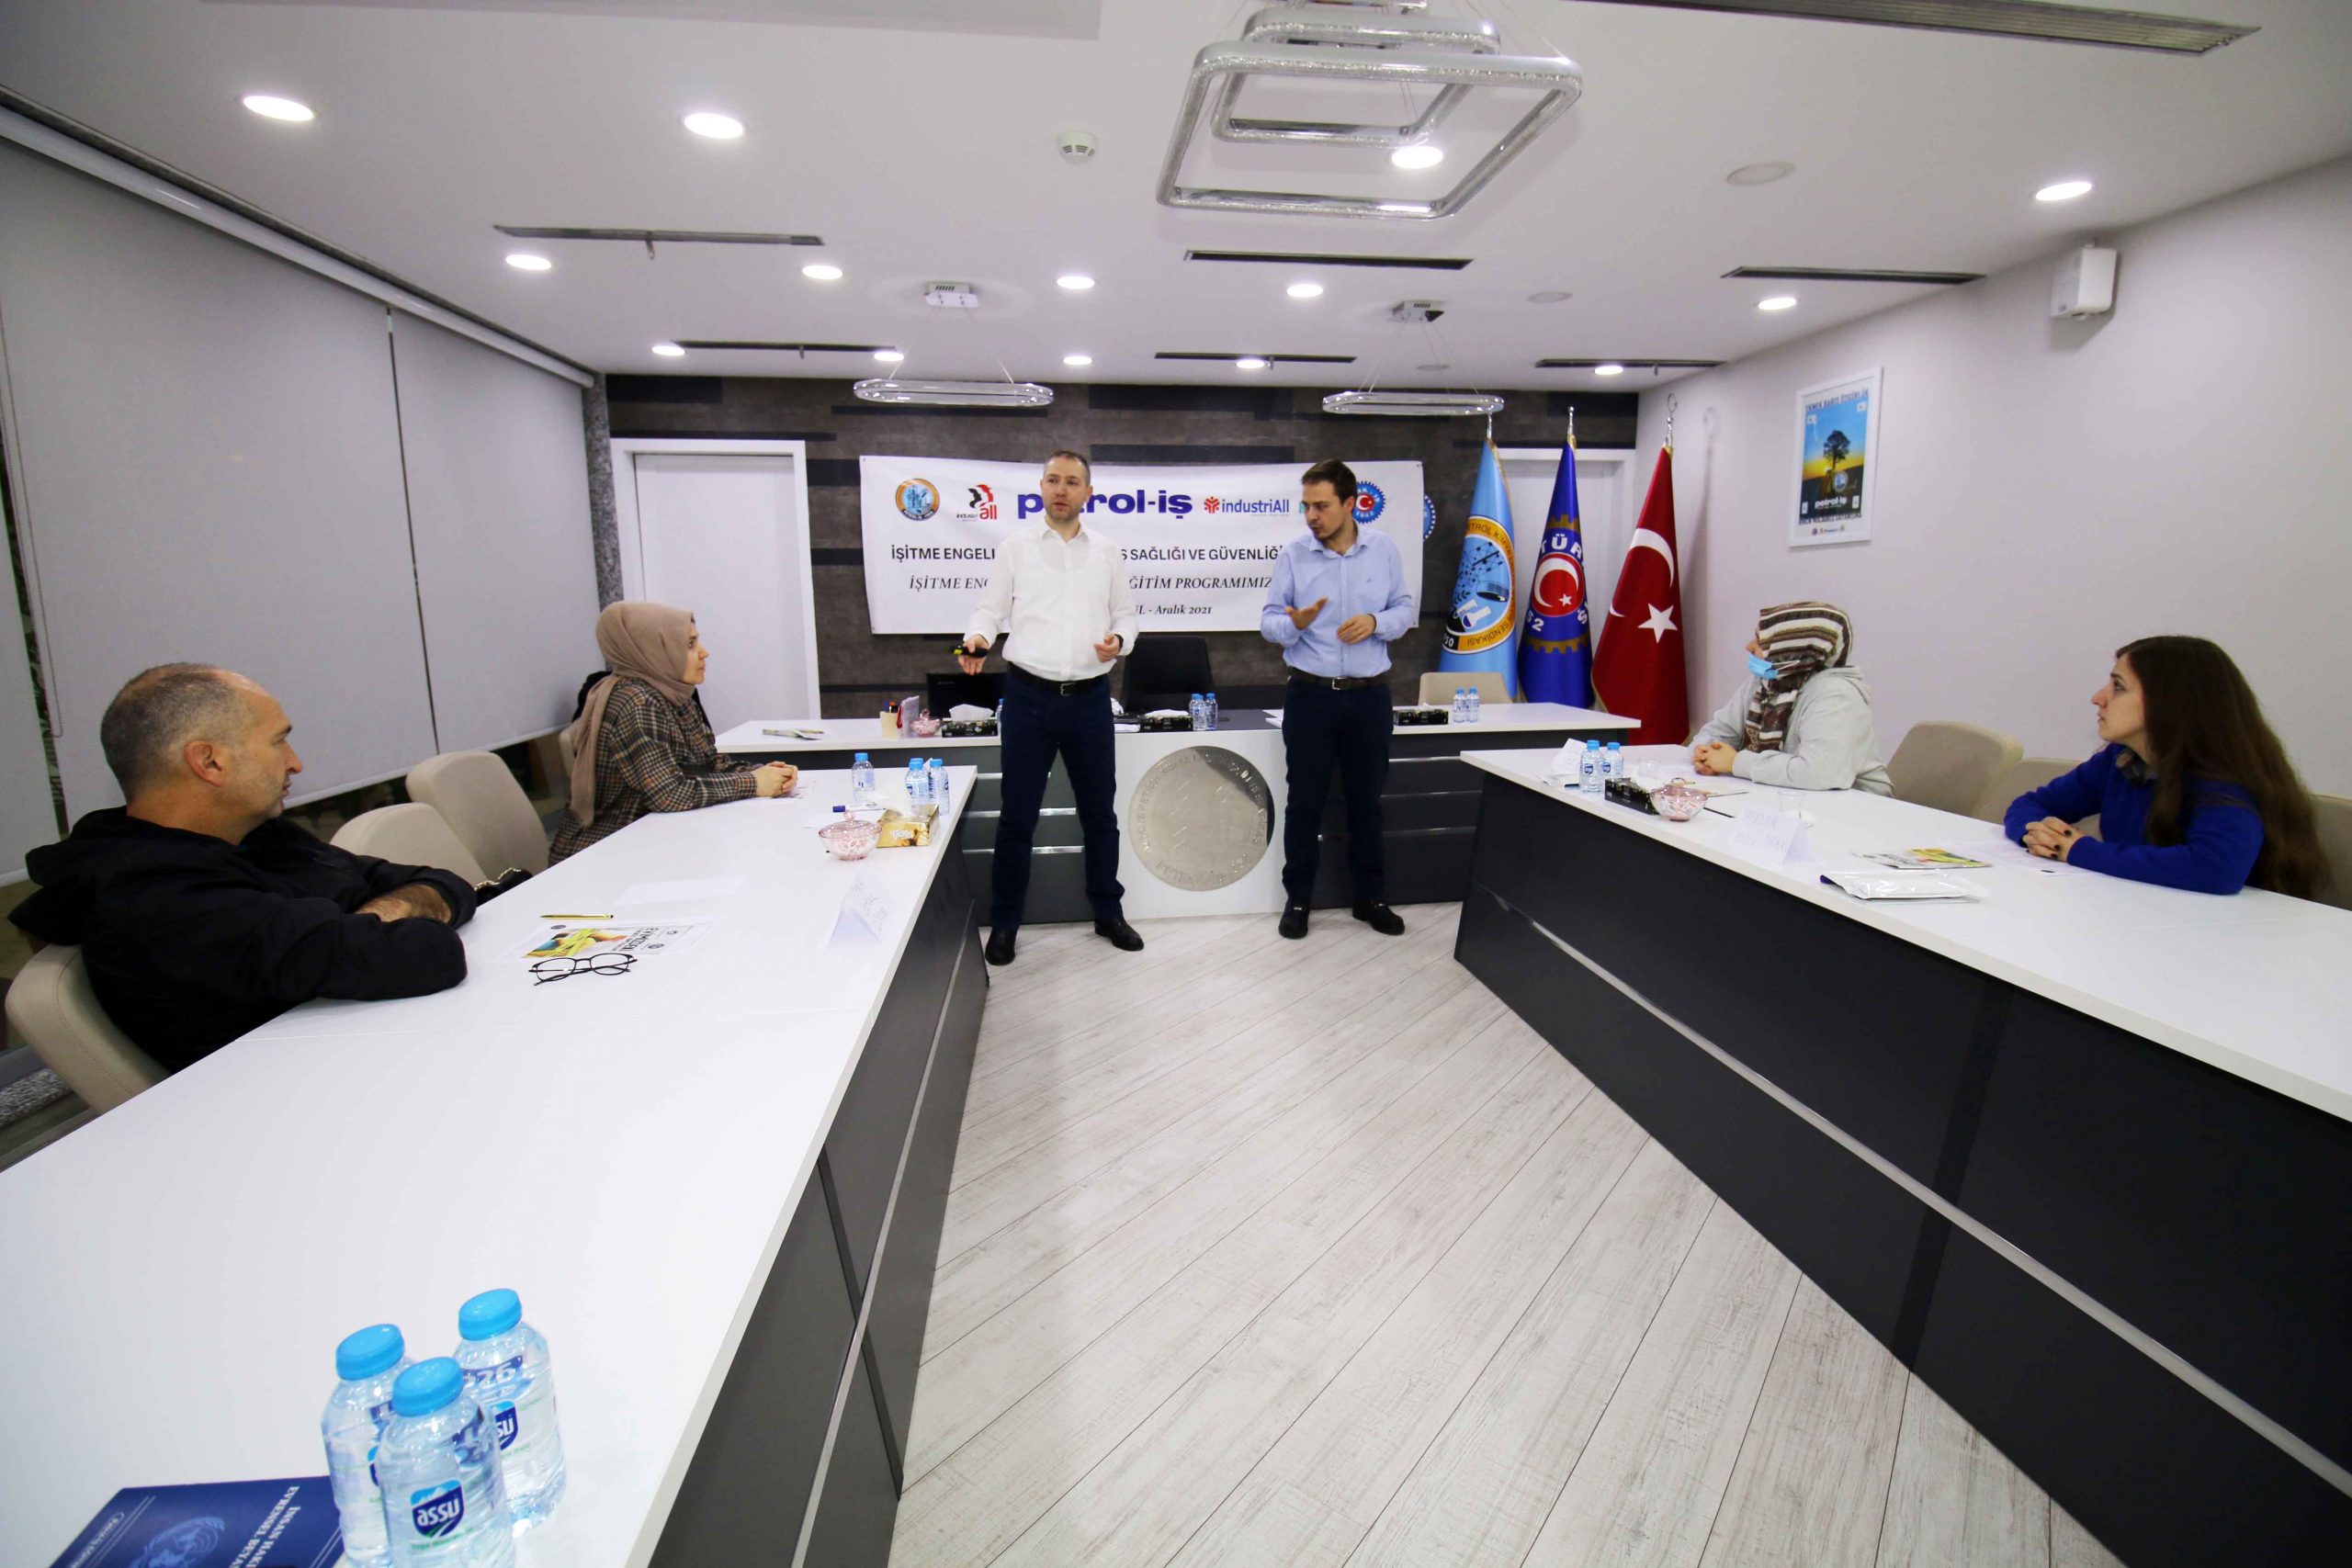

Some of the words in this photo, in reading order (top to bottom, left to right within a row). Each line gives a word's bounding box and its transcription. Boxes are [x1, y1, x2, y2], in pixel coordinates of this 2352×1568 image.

[1018, 490, 1193, 519] prol-iş
[1222, 499, 1290, 513] industriAll
[891, 545, 941, 563] İŞİTME
[1130, 546, 1185, 560] SAĞLIĞI
[1188, 548, 1205, 560] VE
[910, 575, 961, 592] İŞİTME
[1129, 575, 1171, 589] ĞİTİM
[1154, 604, 1186, 615] Aralık
[1188, 606, 1212, 615] 2021
[1467, 621, 1510, 647] SENDİKASI
[254, 1485, 300, 1539] EVRENSEL
[416, 1497, 460, 1527] assu
[229, 1539, 261, 1568] BEYA
